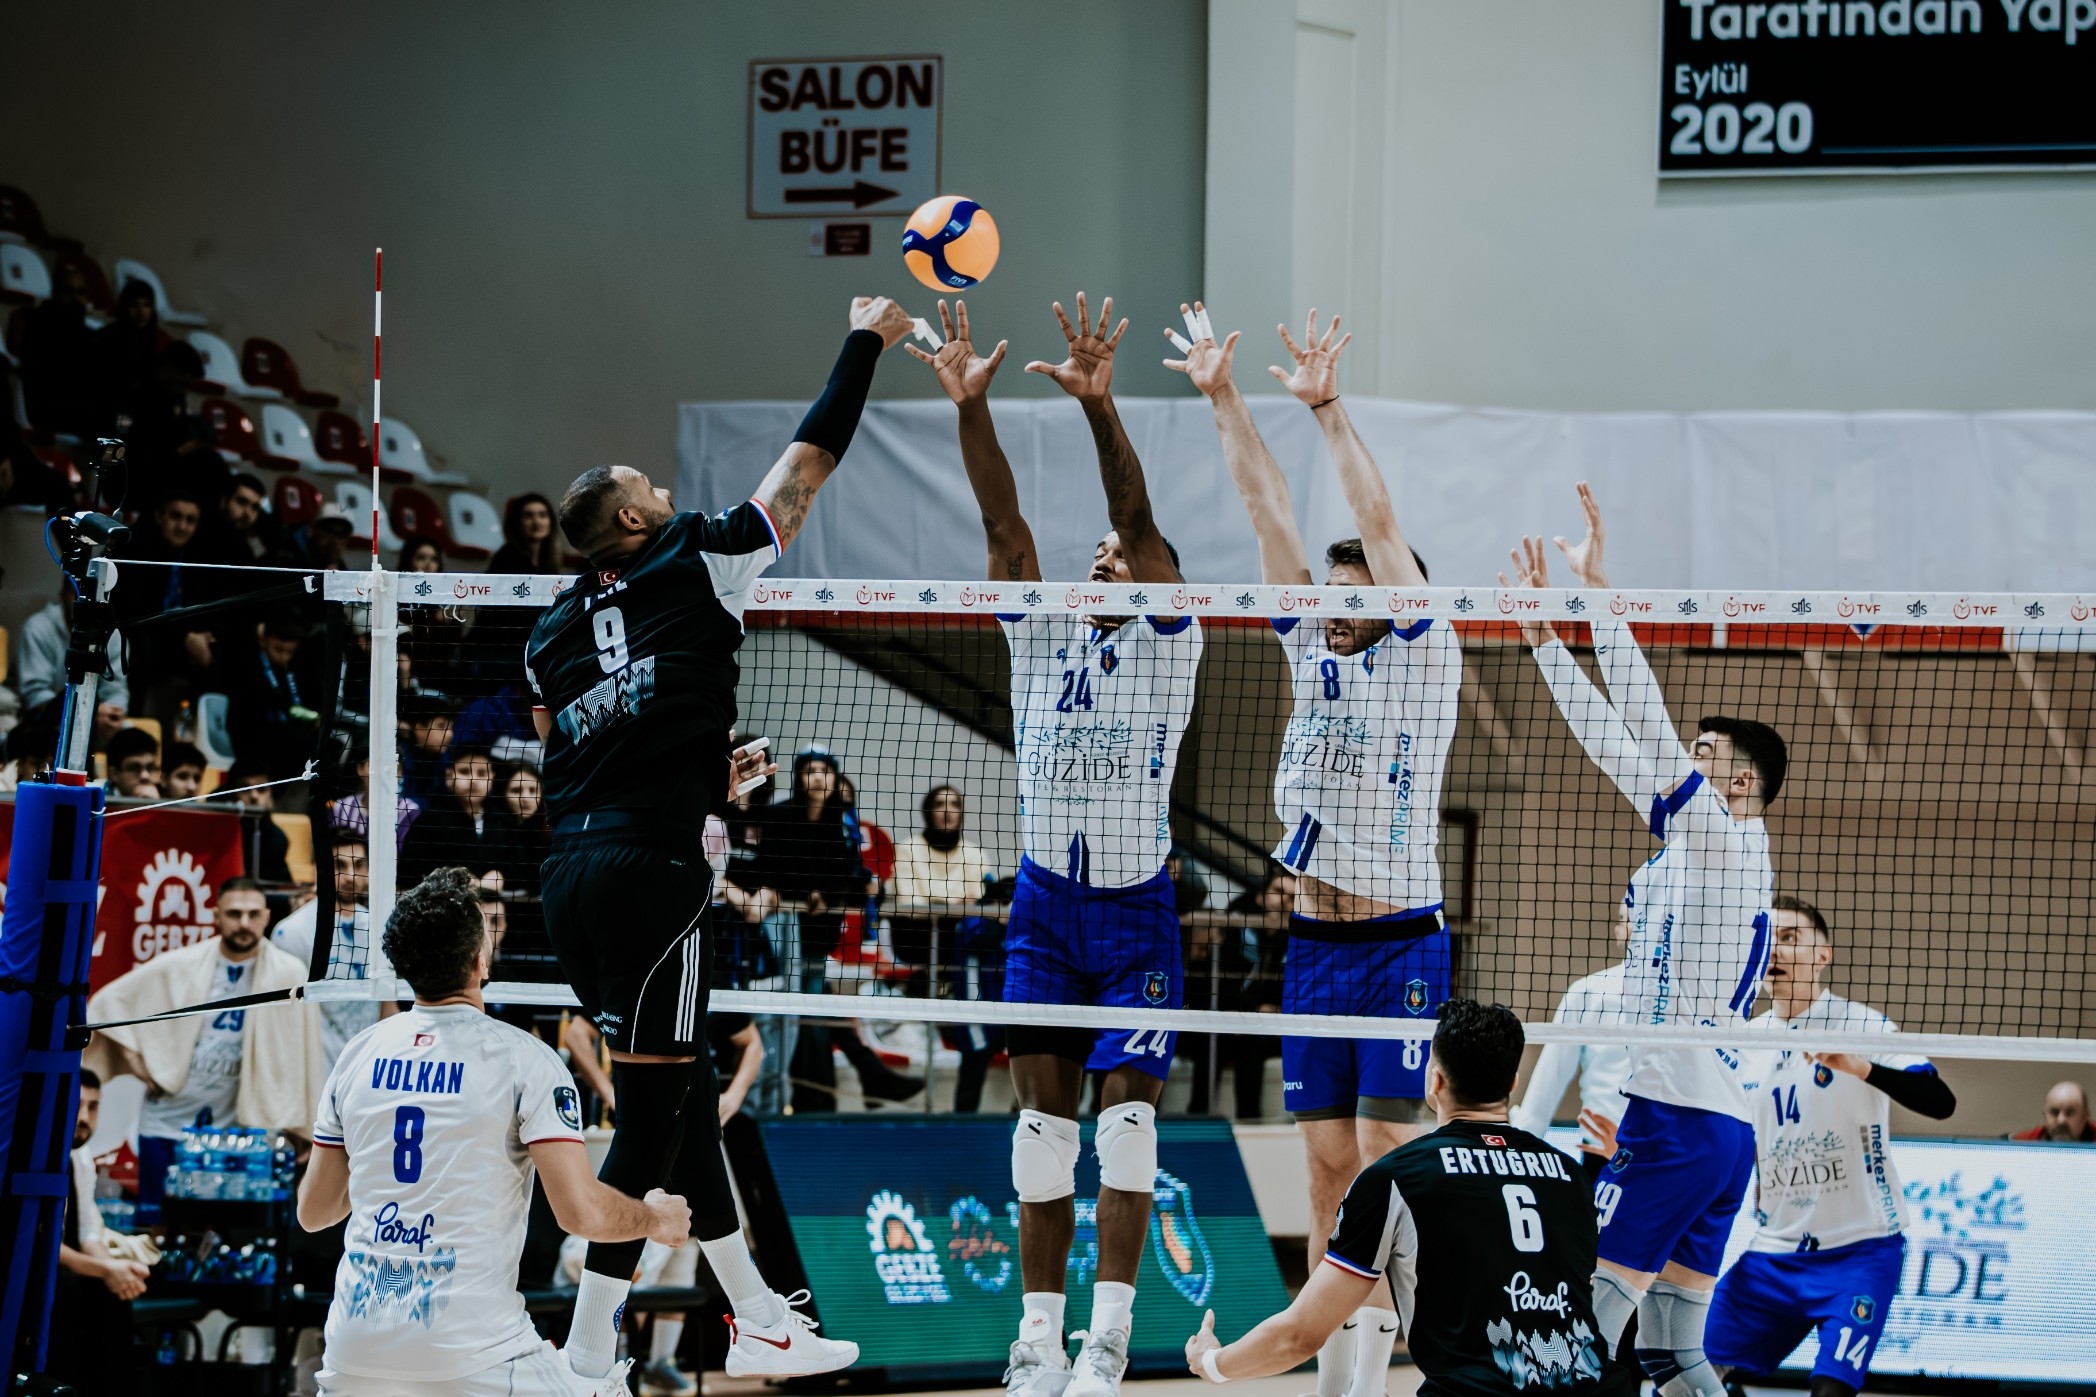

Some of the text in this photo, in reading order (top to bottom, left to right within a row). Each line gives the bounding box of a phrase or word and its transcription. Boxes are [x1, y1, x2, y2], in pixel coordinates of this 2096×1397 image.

[759, 64, 933, 112] SALON
[1674, 63, 1748, 99] Eylül
[780, 118, 909, 174] BÜFE
[1669, 102, 1814, 154] 2020
[470, 586, 491, 596] TVF
[770, 590, 793, 601] TVF
[873, 592, 896, 602] TVF
[978, 593, 1000, 604] TVF
[1083, 595, 1105, 605] TVF
[1189, 596, 1212, 607] TVF
[1297, 597, 1320, 608] TVF
[1405, 599, 1429, 609] TVF
[1517, 601, 1540, 611] TVF
[1629, 602, 1653, 612] TVF
[1741, 603, 1765, 613] TVF
[1857, 604, 1881, 615] TVF
[1973, 606, 1998, 616] TVF
[592, 606, 630, 674] 9
[1056, 667, 1094, 713] 24
[1320, 658, 1341, 700] 8
[1028, 752, 1132, 781] GÜZİDE
[1123, 1029, 1168, 1059] 24
[1402, 1039, 1422, 1070] 8
[371, 1058, 465, 1094] VOLKAN
[1772, 1083, 1801, 1127] 14
[393, 1105, 425, 1184] 8
[1439, 1147, 1572, 1182] ERTUĞRUL
[1502, 1184, 1544, 1252] 6
[1834, 1326, 1871, 1371] 14
